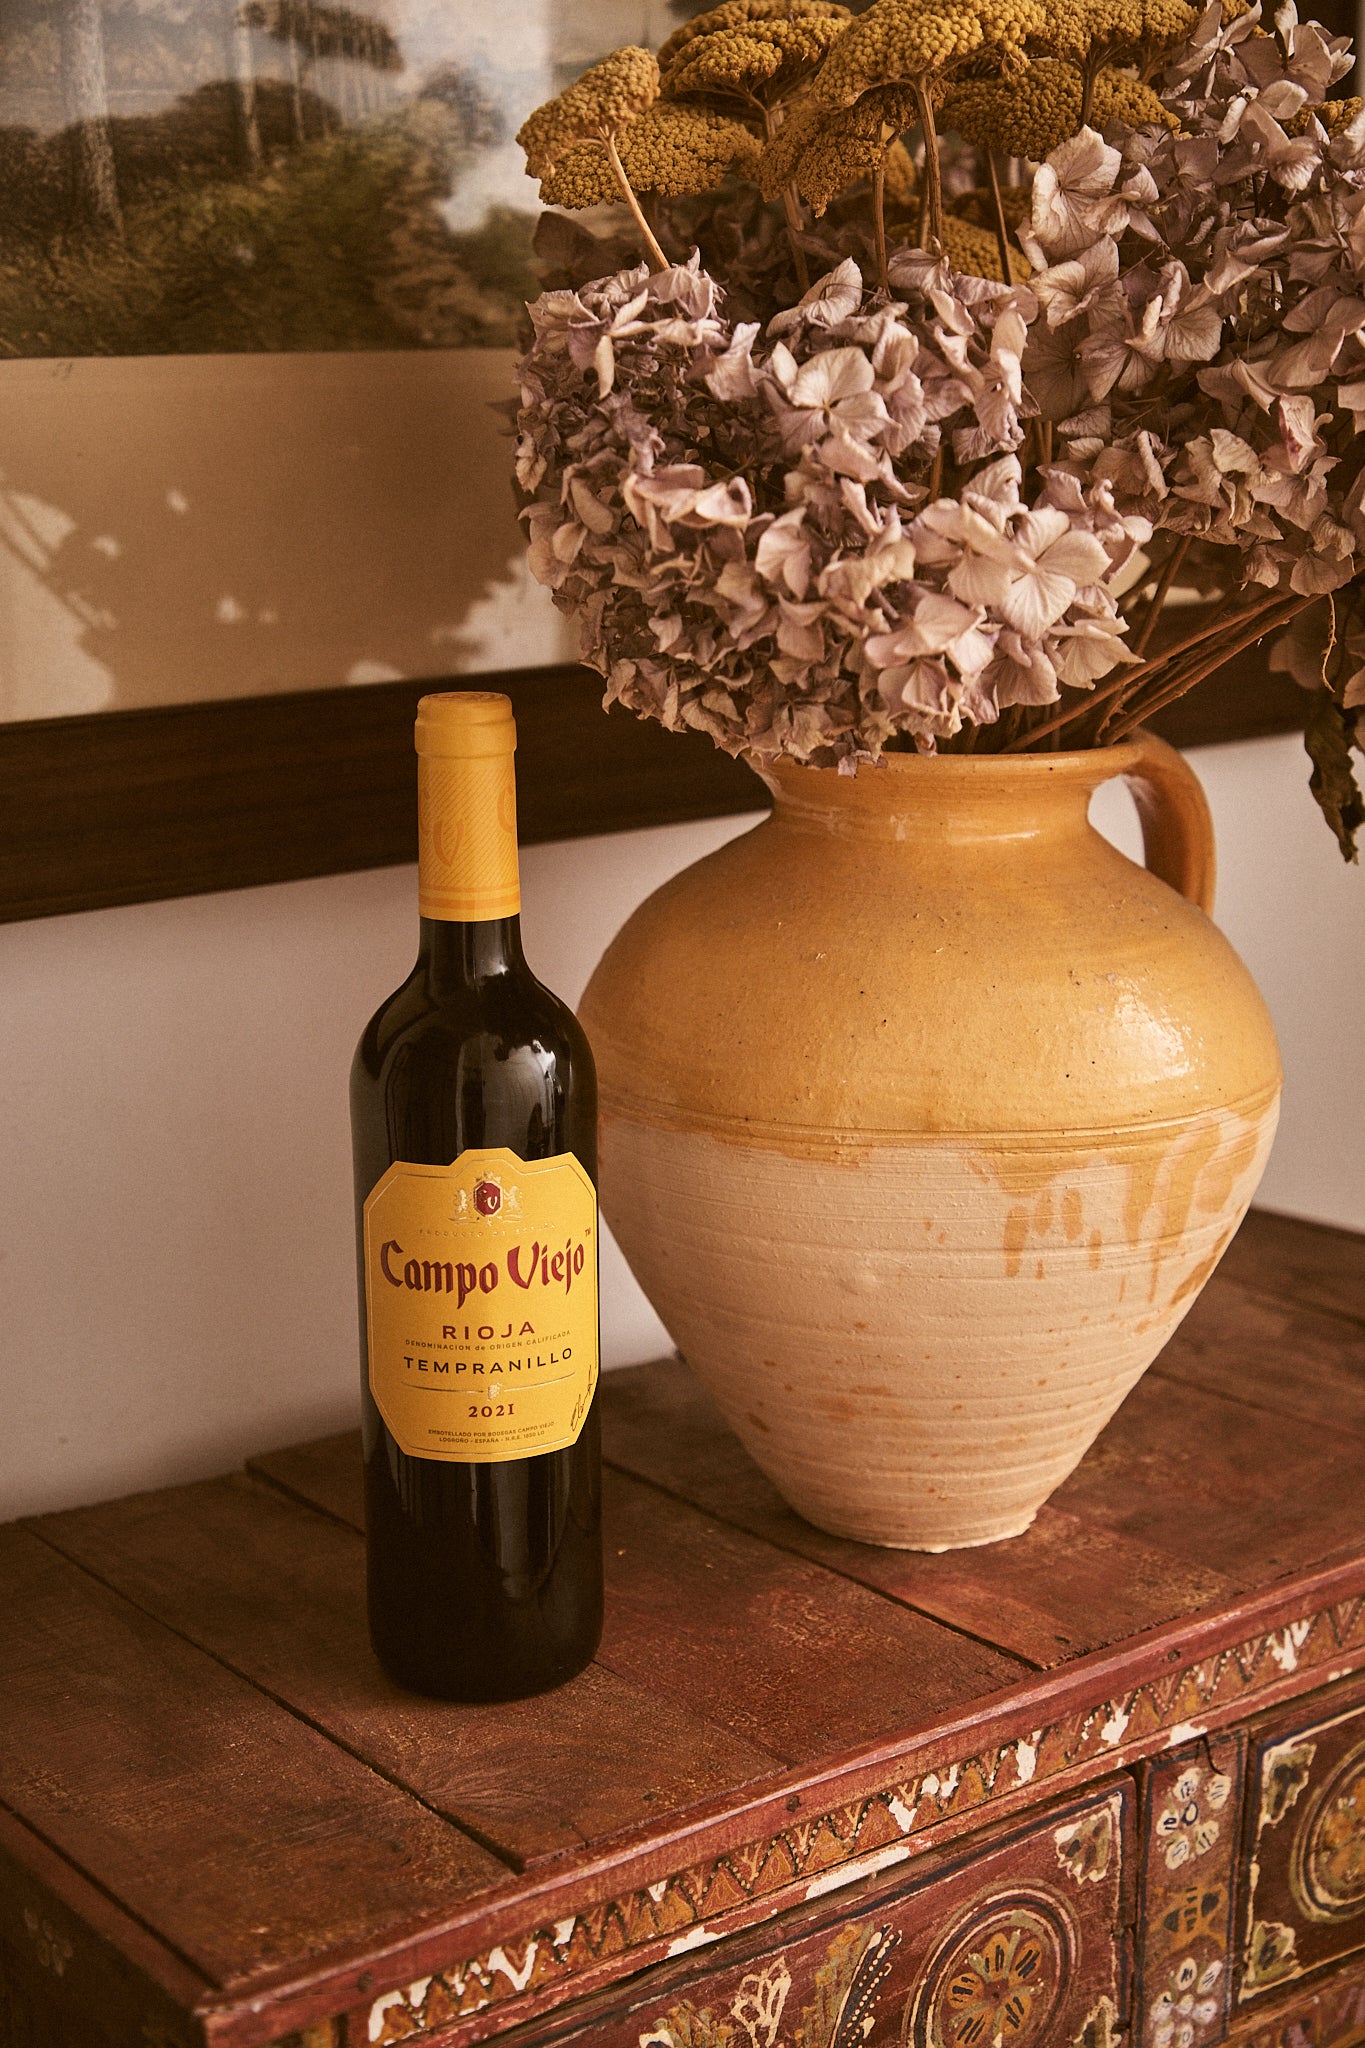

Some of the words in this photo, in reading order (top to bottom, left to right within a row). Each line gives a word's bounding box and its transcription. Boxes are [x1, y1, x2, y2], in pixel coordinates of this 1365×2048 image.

[380, 1239, 499, 1309] Campo
[507, 1238, 585, 1295] Viejo
[442, 1321, 535, 1340] RIOJA
[489, 1341, 523, 1351] ORIGEN
[526, 1330, 571, 1345] CALIFICADA
[403, 1347, 573, 1375] TEMPRANILLO
[468, 1403, 516, 1418] 2021
[428, 1429, 472, 1437] EMBOTELLADO
[487, 1429, 517, 1437] BODEGAS
[517, 1425, 538, 1433] CAMPO
[539, 1421, 555, 1429] VIEJO
